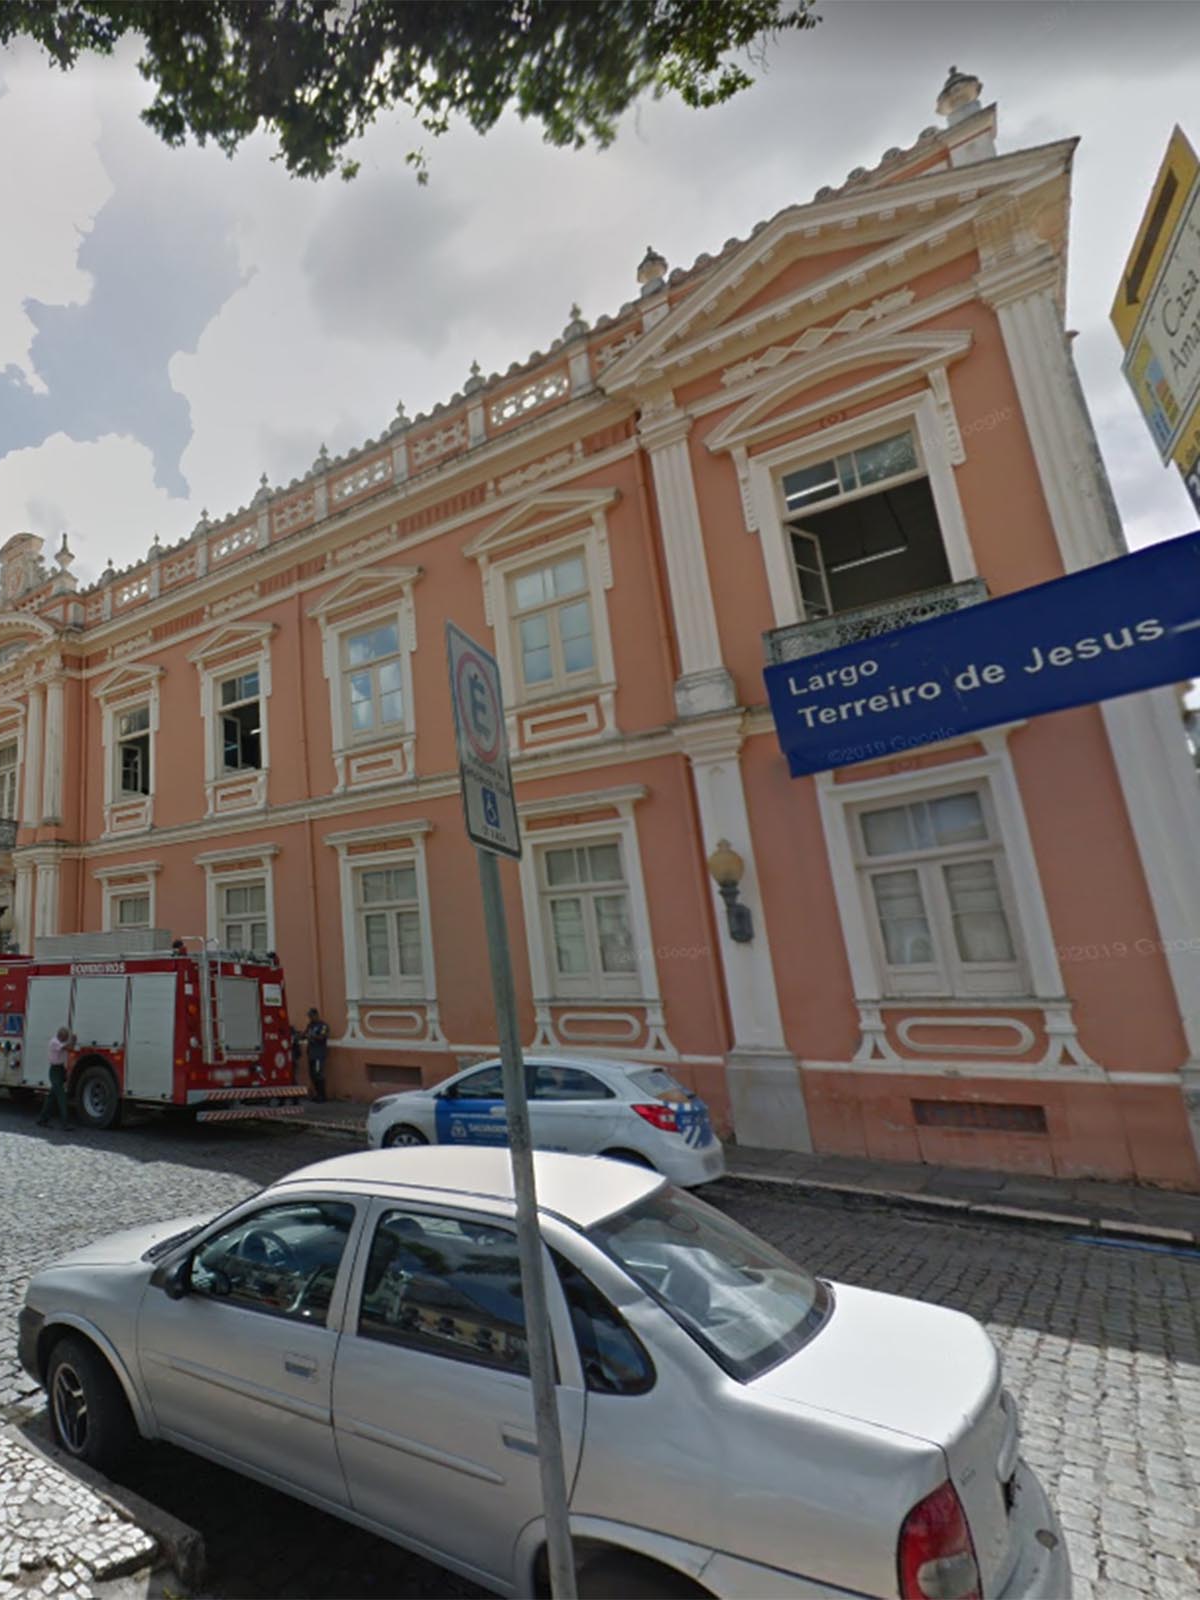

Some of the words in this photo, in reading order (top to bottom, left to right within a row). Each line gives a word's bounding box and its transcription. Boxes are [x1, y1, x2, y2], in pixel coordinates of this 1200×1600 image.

[788, 660, 879, 696] Largo
[797, 681, 942, 728] Terreiro
[954, 663, 1006, 691] de
[1023, 618, 1165, 674] Jesus
